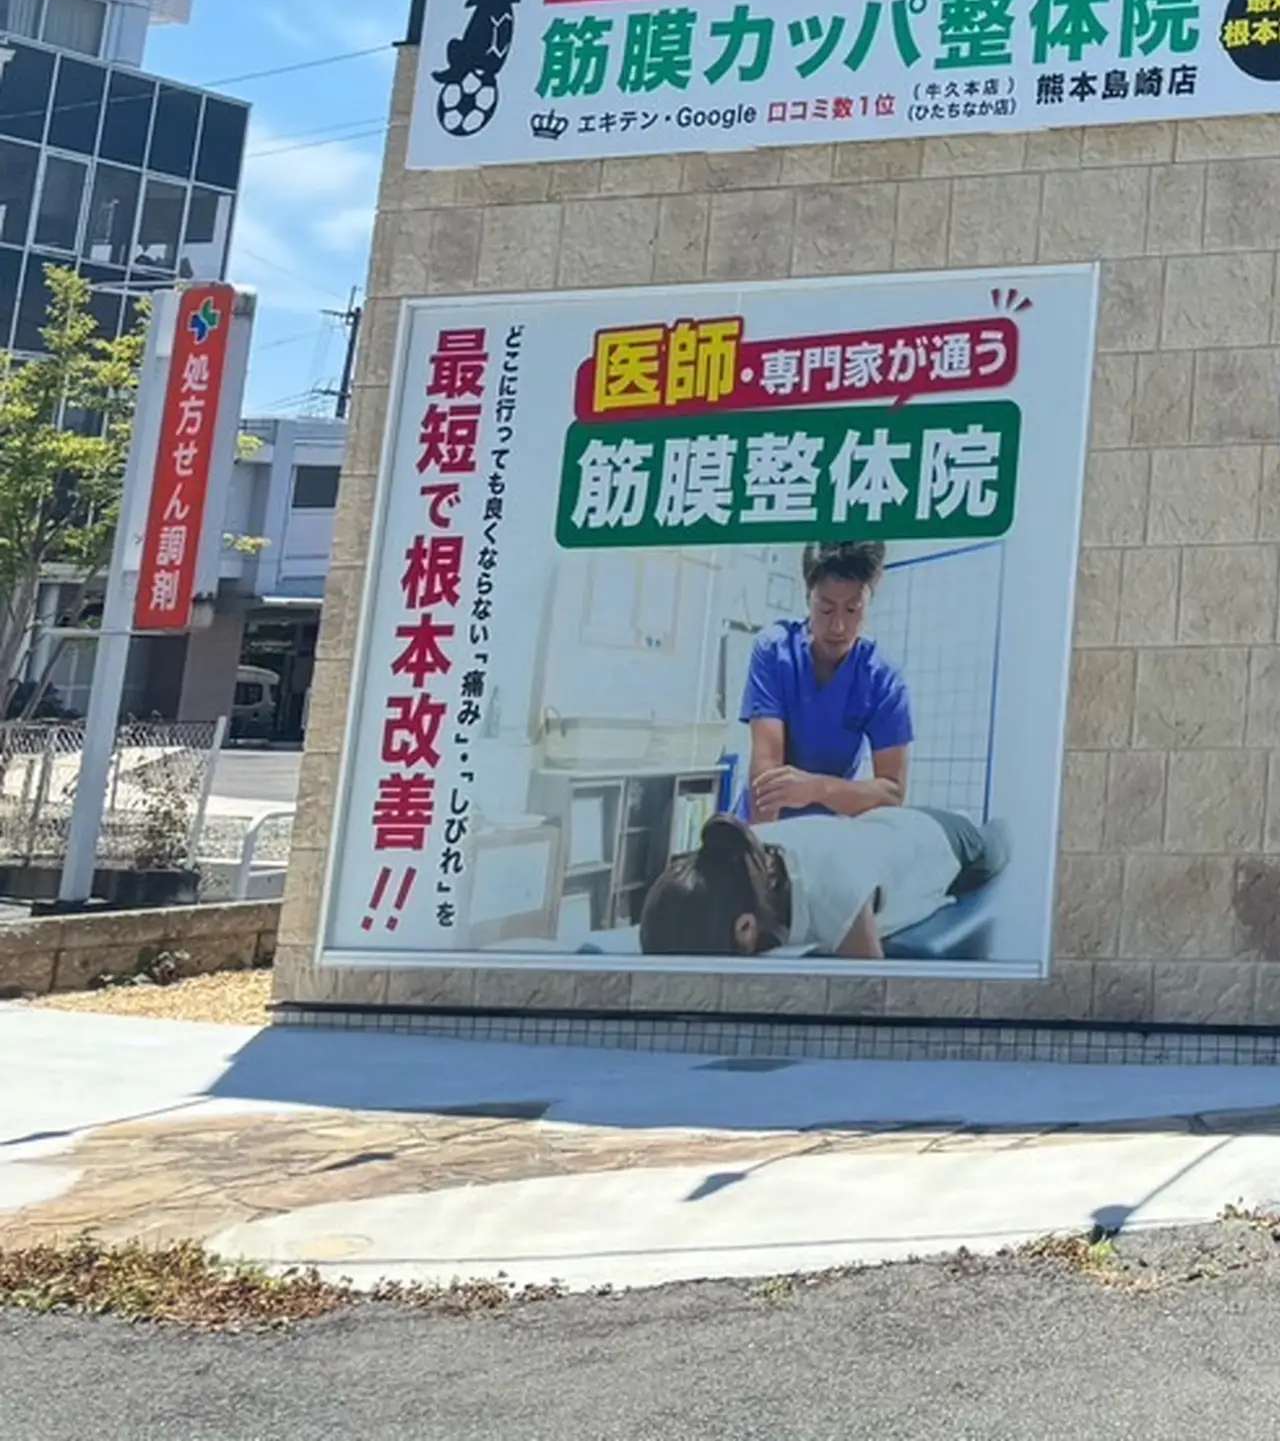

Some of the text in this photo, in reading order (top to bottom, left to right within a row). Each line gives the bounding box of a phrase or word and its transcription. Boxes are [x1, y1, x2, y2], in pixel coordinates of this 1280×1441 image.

[767, 93, 896, 123] 口コミ数1位
[907, 98, 1018, 123] (ひたちなか店)
[1036, 64, 1198, 104] 熊本島崎店
[591, 318, 1010, 412] 医師・専門家が通う
[150, 353, 210, 611] 処方せん調剤
[571, 426, 1003, 529] 筋膜整体院
[361, 327, 489, 932] 最短で根本改善!!
